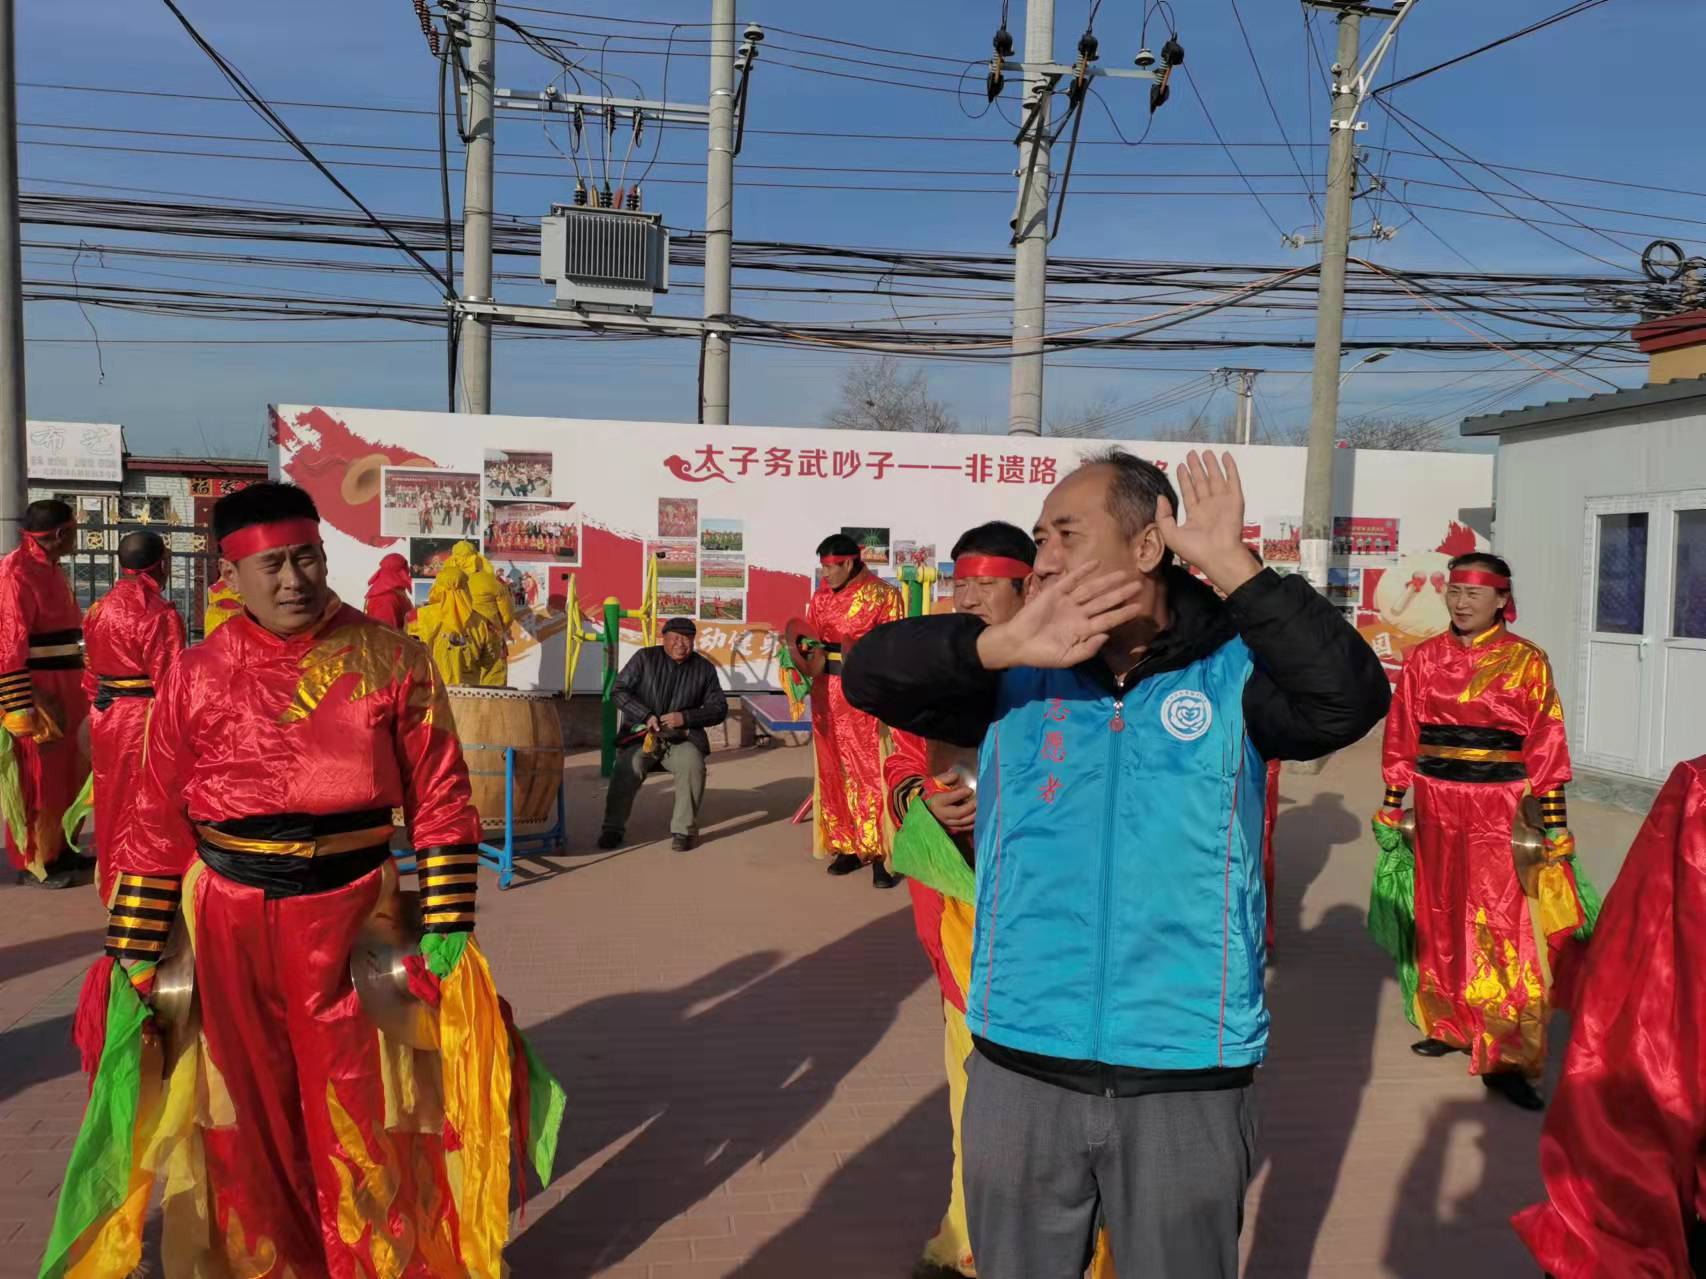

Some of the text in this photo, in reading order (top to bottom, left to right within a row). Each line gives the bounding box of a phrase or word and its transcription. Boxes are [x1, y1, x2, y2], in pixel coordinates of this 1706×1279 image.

[693, 626, 780, 657] 动健身
[1036, 696, 1071, 804] 志愿者
